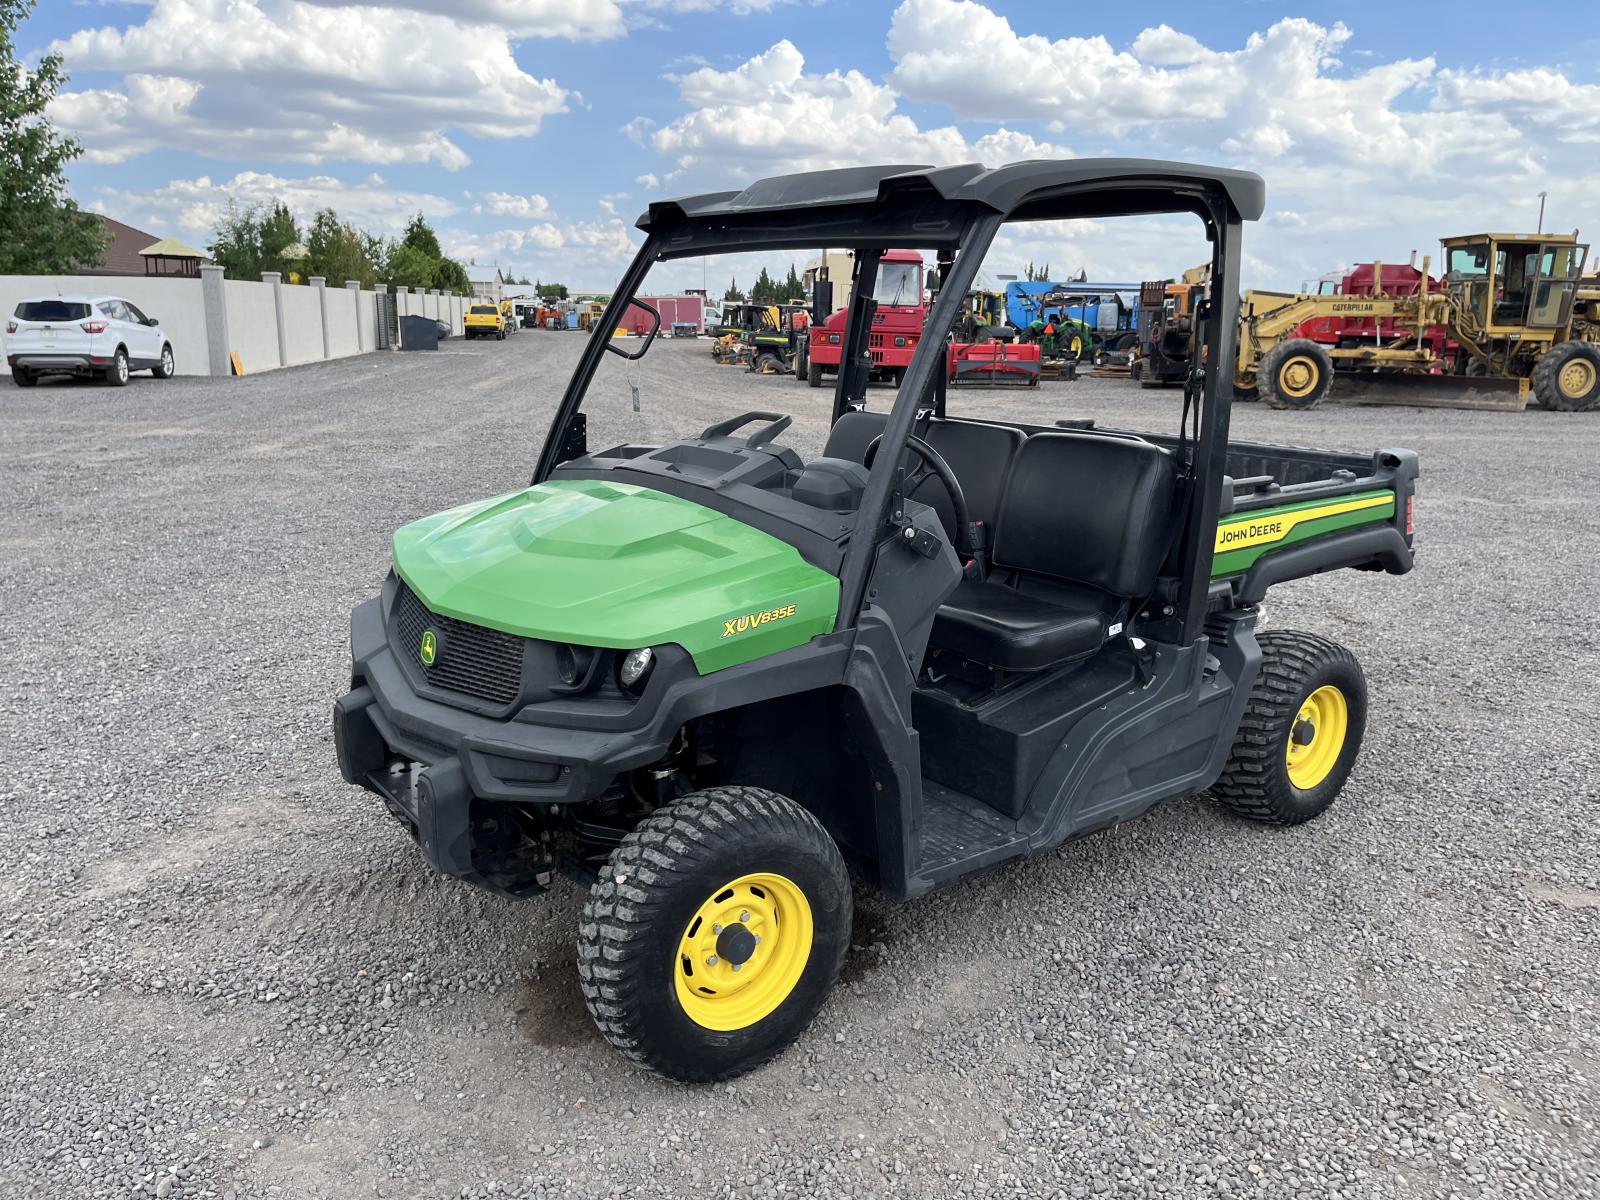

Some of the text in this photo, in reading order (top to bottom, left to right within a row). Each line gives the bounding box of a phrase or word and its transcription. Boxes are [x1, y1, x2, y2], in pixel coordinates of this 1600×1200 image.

[1332, 303, 1373, 311] CATERPILLAR
[1219, 522, 1282, 544] JOHN DEERE
[721, 604, 796, 638] XUV835E
